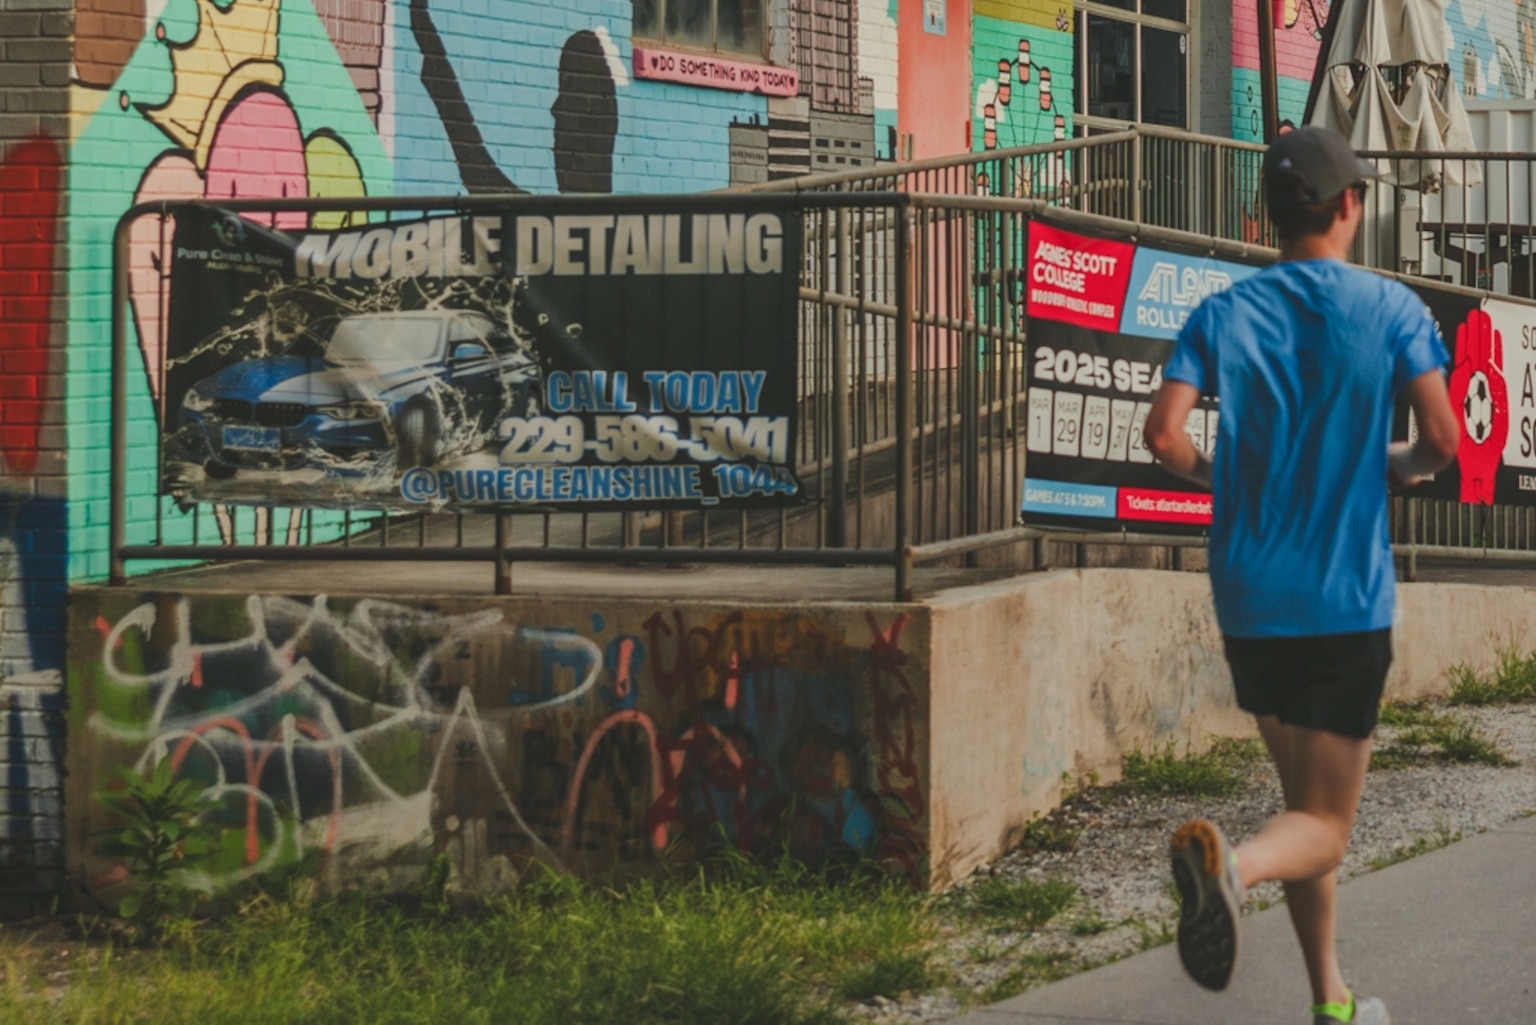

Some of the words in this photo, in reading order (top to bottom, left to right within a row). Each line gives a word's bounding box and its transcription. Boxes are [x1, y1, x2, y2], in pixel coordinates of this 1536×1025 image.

[659, 55, 675, 71] DO
[680, 58, 736, 81] SOMETHING
[740, 69, 760, 83] KIND
[762, 71, 790, 89] TODAY
[177, 247, 208, 259] Pure
[295, 215, 501, 279] MOBILE
[515, 213, 784, 275] DETAILING
[1034, 240, 1074, 270] AGNES
[1072, 250, 1118, 277] SCOTT
[1032, 262, 1086, 294] COLLEGE
[1136, 305, 1190, 330] ROLLE
[1034, 346, 1112, 389] 2025
[1112, 359, 1163, 394] SEA
[547, 370, 636, 413] CALL
[644, 370, 766, 414] TODAY
[1031, 397, 1049, 411] MAR
[1057, 400, 1079, 416] MAR
[1088, 405, 1106, 419] APR
[500, 415, 790, 465] 229-586-5041
[1036, 416, 1042, 440] 1
[1057, 418, 1077, 443] 29
[1087, 422, 1104, 447] 19
